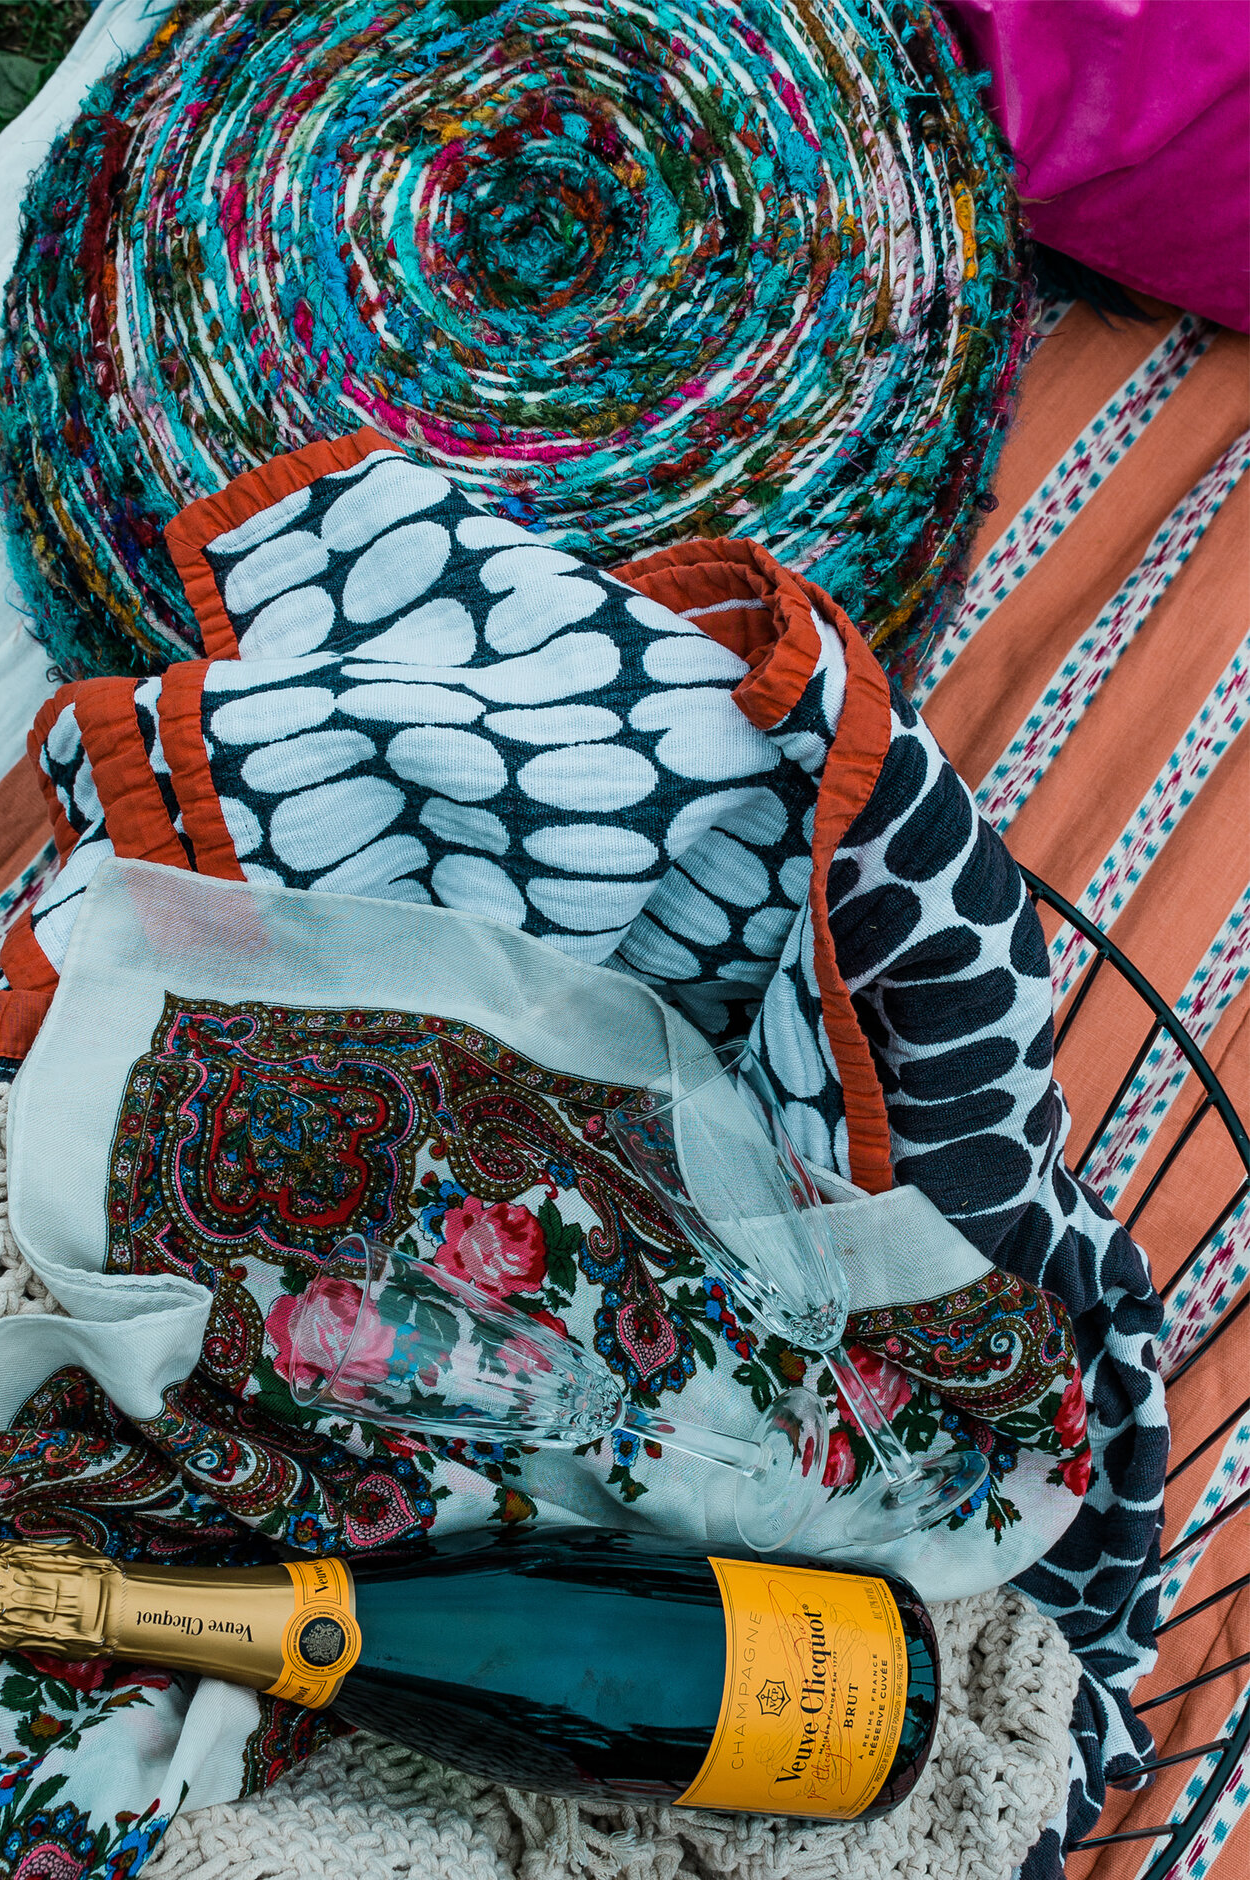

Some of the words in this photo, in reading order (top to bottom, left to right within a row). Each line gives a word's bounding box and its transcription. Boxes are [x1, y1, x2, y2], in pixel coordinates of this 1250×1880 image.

[314, 1564, 329, 1594] Veuve
[136, 1610, 204, 1636] Clicquot
[208, 1619, 254, 1643] Veuve
[732, 1611, 762, 1770] CHAMPAGNE
[843, 1683, 858, 1728] BRUT
[868, 1704, 885, 1756] RÉSERVE
[878, 1660, 887, 1699] CUVÉE
[862, 1710, 874, 1747] REIMS
[774, 1722, 819, 1784] Veuve
